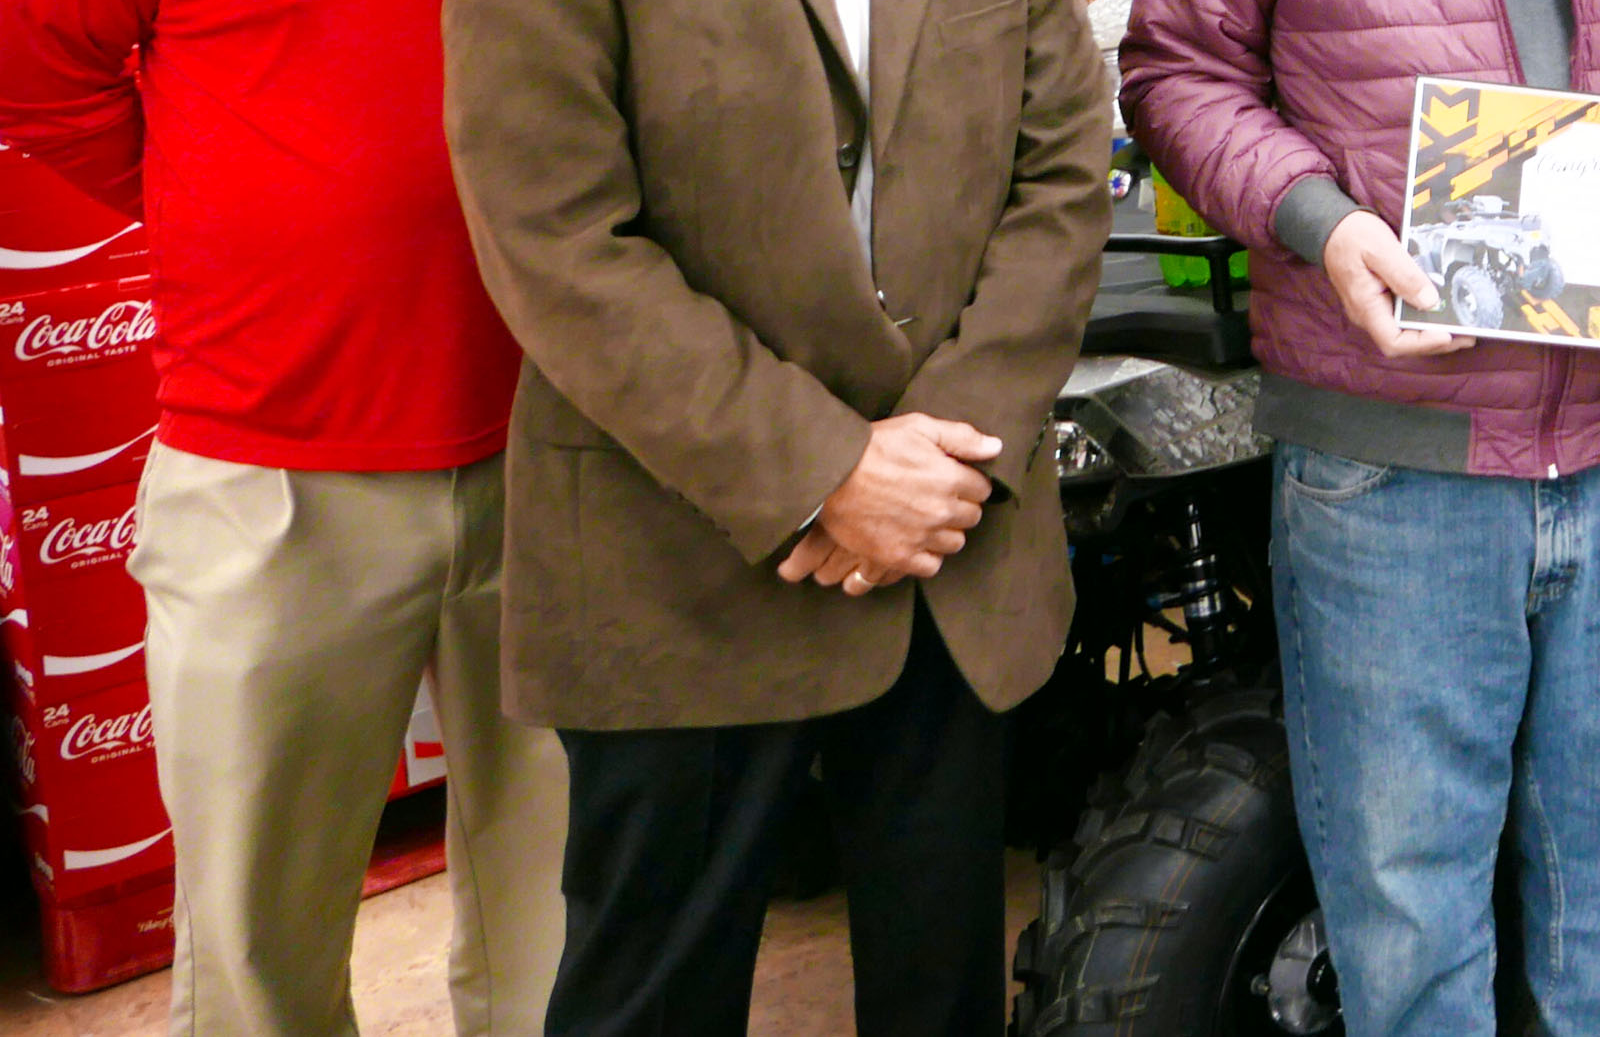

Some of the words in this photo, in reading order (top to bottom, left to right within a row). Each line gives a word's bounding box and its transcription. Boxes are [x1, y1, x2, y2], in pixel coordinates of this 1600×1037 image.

[15, 300, 156, 361] Coca-Cola
[47, 352, 100, 367] ORIGINAL
[104, 344, 137, 356] TASTE
[22, 506, 49, 524] 24
[23, 520, 49, 531] Cans
[39, 506, 137, 564] Coca-C
[70, 552, 123, 569] ORIGINAL
[43, 703, 70, 722] 24
[60, 703, 155, 760] Coca-C
[90, 745, 143, 763] ORIGINAL
